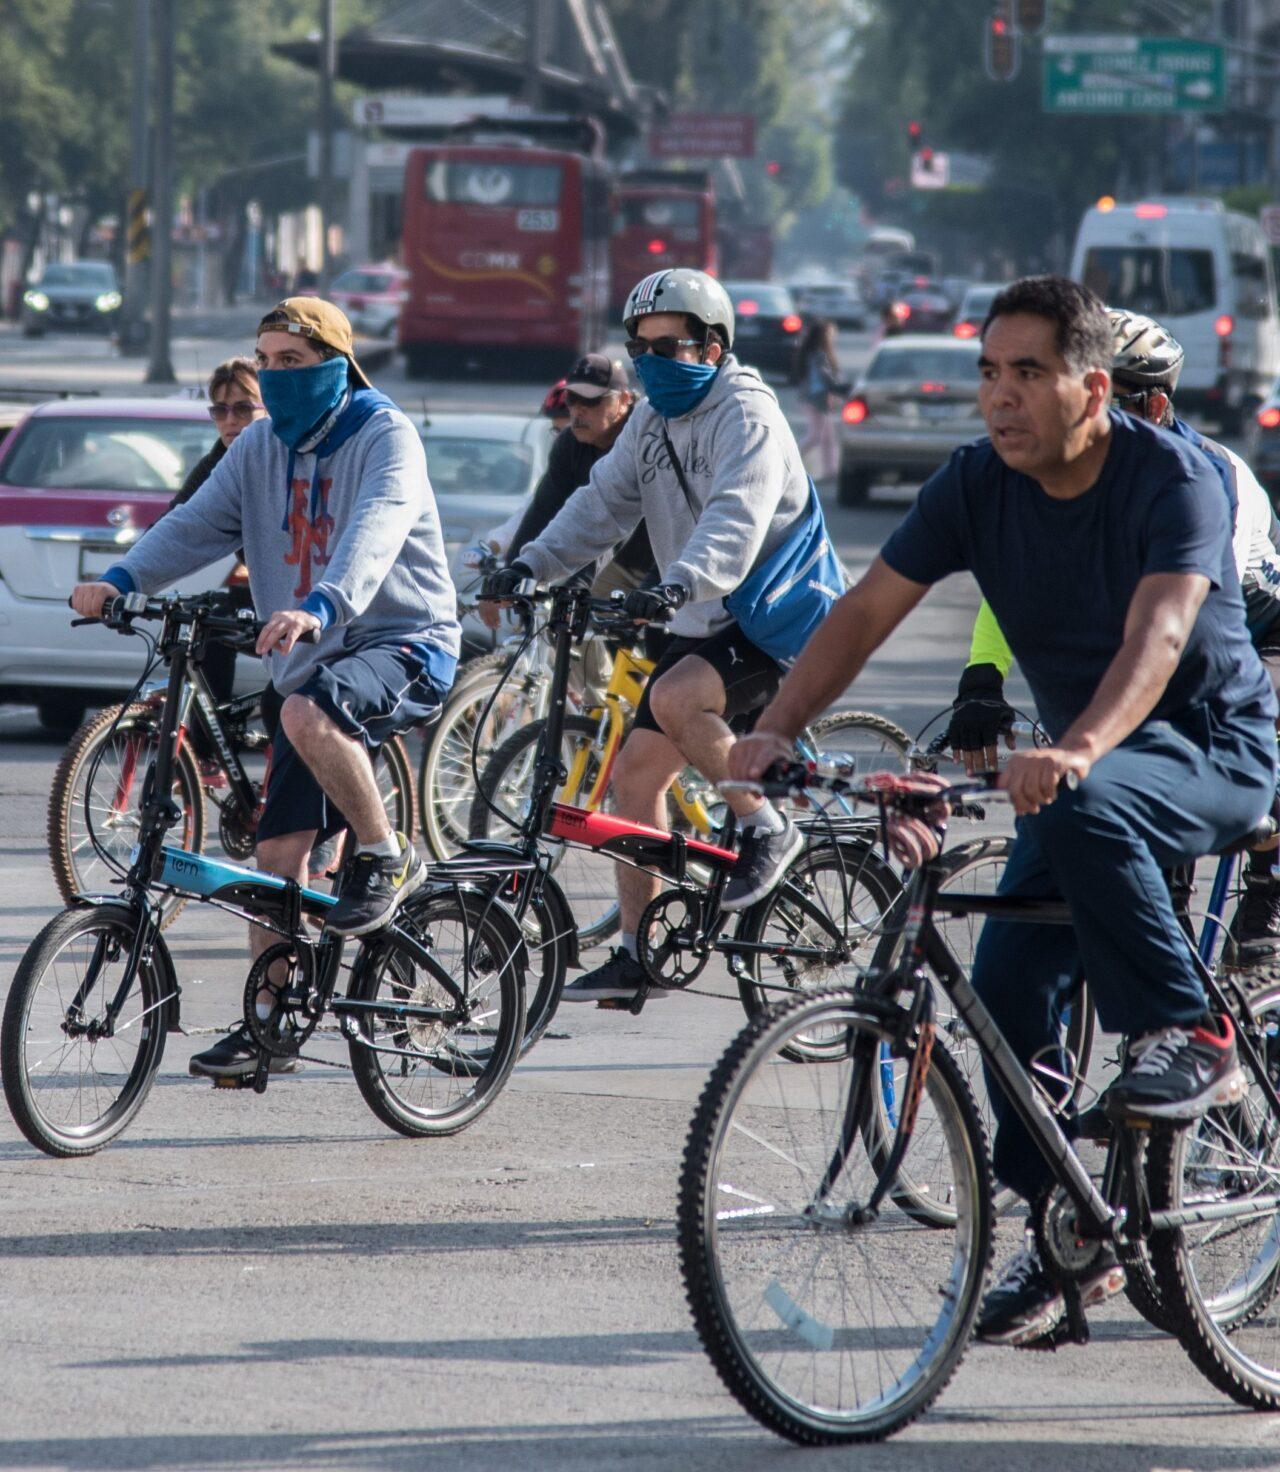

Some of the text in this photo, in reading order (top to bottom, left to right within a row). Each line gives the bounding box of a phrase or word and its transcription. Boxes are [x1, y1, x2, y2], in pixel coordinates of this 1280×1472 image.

[520, 210, 555, 230] 253
[459, 252, 520, 269] CDMX
[561, 810, 588, 832] tern
[171, 855, 200, 878] tern
